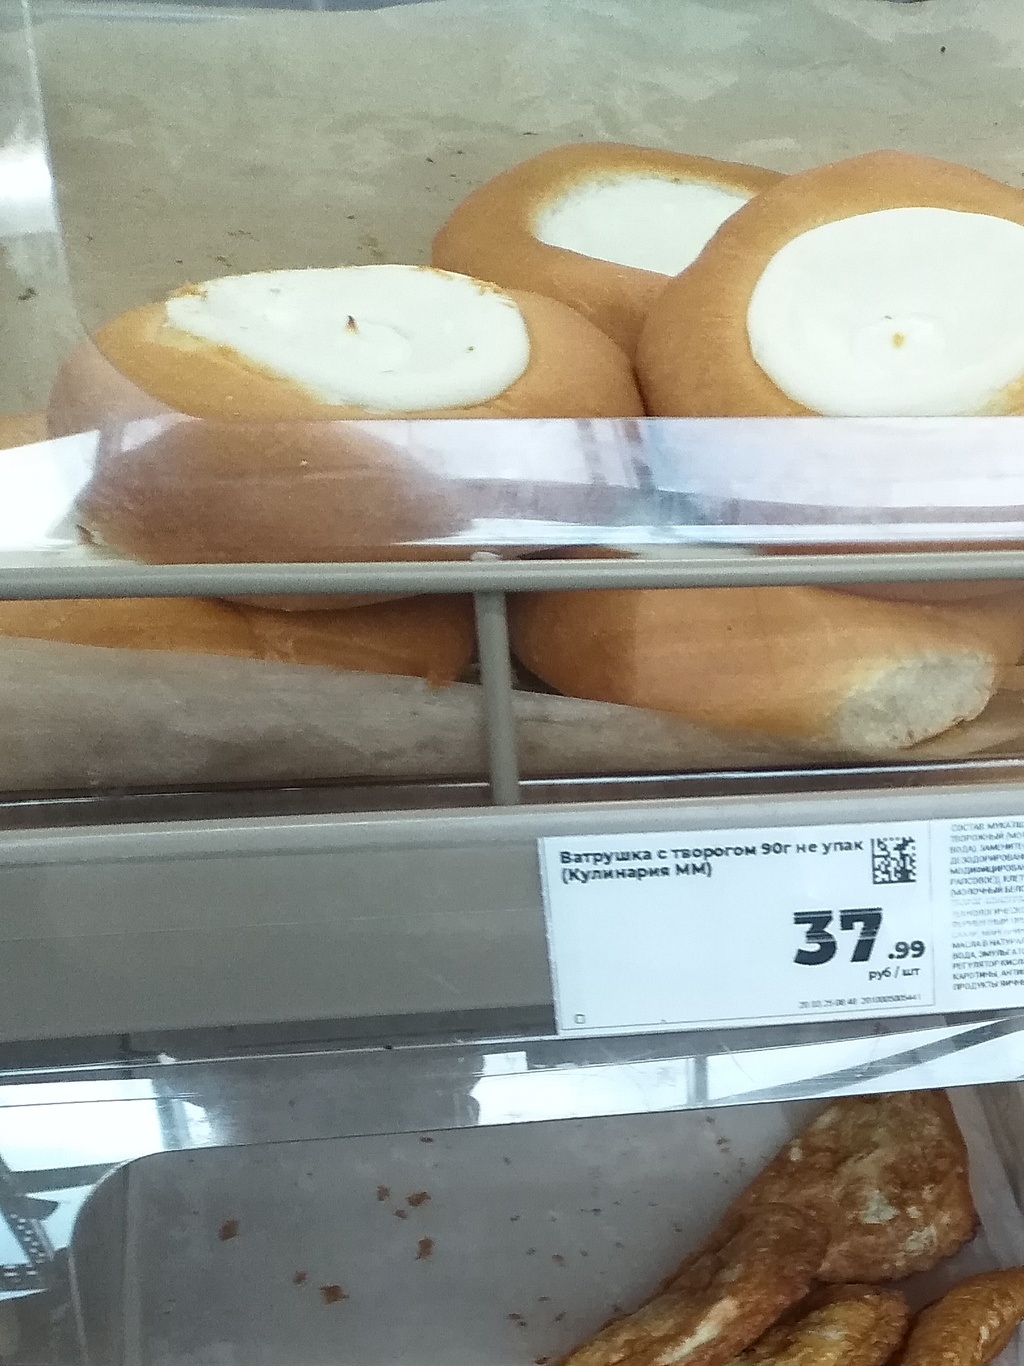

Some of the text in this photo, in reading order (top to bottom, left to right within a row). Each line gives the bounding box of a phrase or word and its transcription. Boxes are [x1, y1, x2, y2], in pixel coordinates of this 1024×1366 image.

[560, 840, 864, 866] Ватрушка с творогом 90г не упак
[562, 861, 712, 885] (Кулинария ММ)
[868, 967, 892, 981] руб
[902, 968, 920, 977] шт
